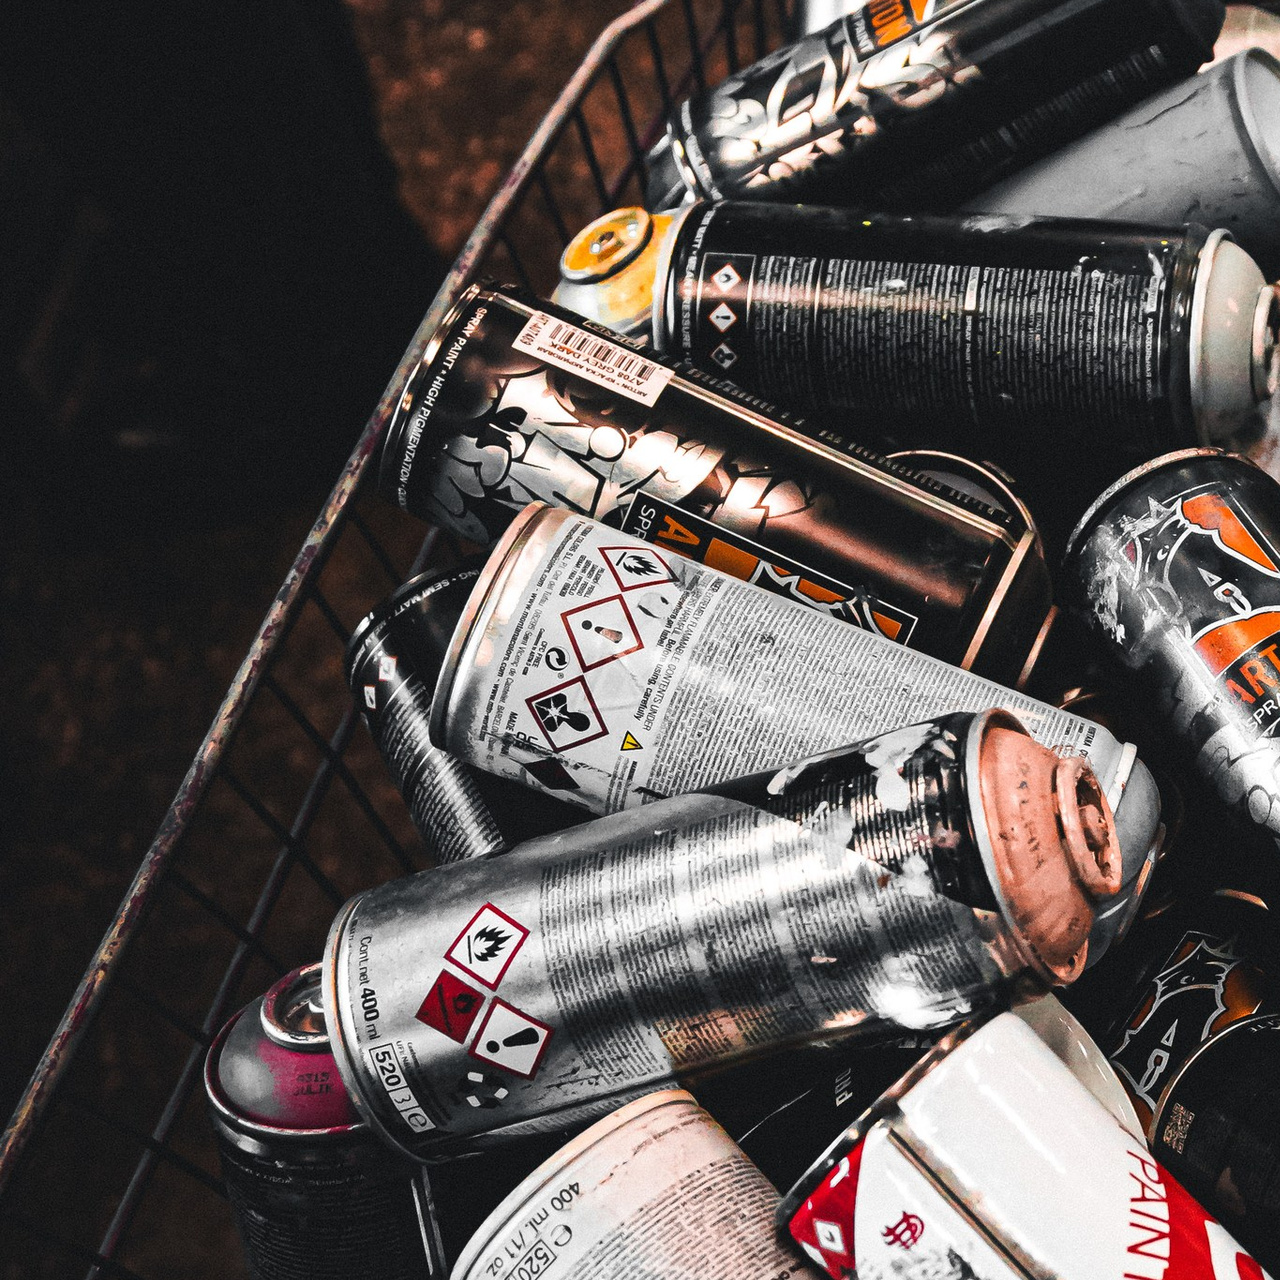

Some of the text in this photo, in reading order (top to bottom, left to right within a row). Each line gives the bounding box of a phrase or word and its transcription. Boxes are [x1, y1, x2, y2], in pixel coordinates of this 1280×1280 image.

[549, 340, 644, 386] A708 GREY DARK
[398, 305, 487, 483] SPRAY PAINT HIGH PIGMENTATION
[391, 577, 450, 616] SEMI MATT
[495, 591, 537, 678] www.montanacolors.com
[652, 662, 677, 704] CONTENTS
[642, 703, 659, 731] UNDER
[358, 985, 380, 1022] 400
[373, 1048, 402, 1088] 520
[548, 1178, 584, 1213] 400
[523, 1207, 552, 1236] ml.
